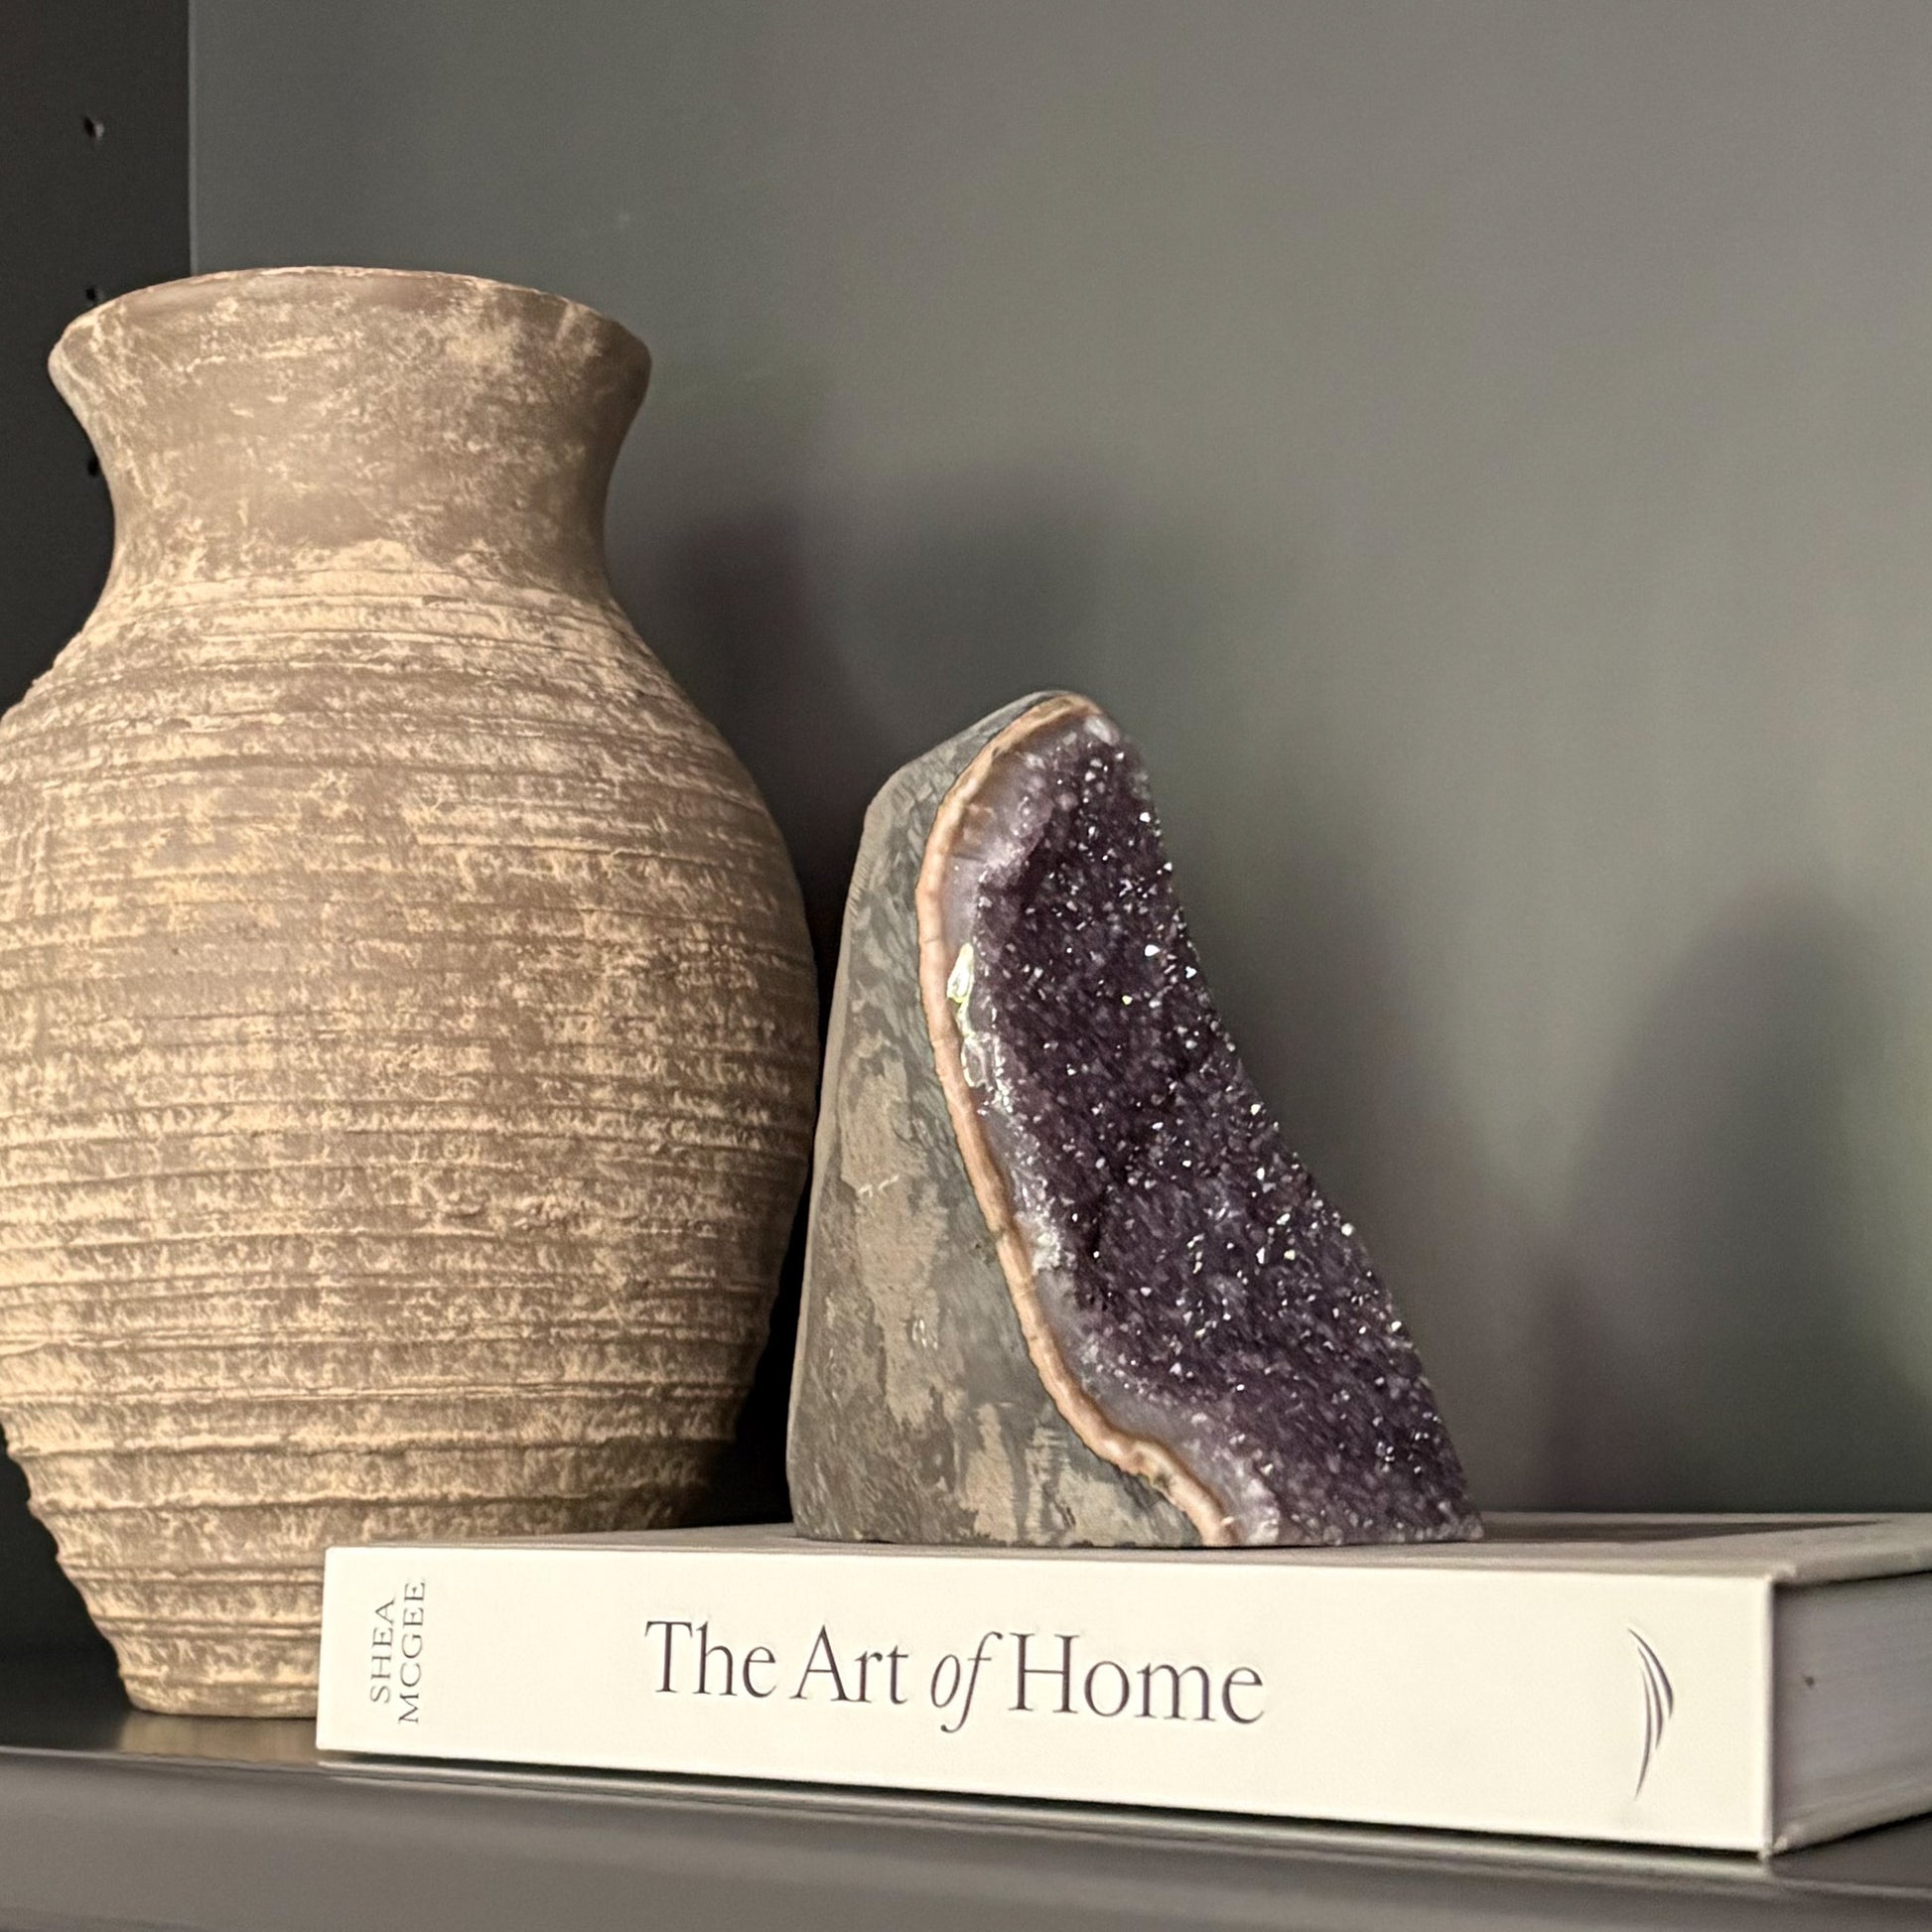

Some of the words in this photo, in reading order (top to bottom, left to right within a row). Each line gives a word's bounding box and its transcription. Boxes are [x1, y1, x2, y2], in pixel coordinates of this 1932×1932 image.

[369, 1598, 395, 1704] SHEA
[398, 1582, 425, 1724] MCGEE
[645, 1620, 777, 1699] The
[789, 1625, 909, 1705] Art
[930, 1631, 1003, 1733] of
[1009, 1632, 1265, 1725] Home
